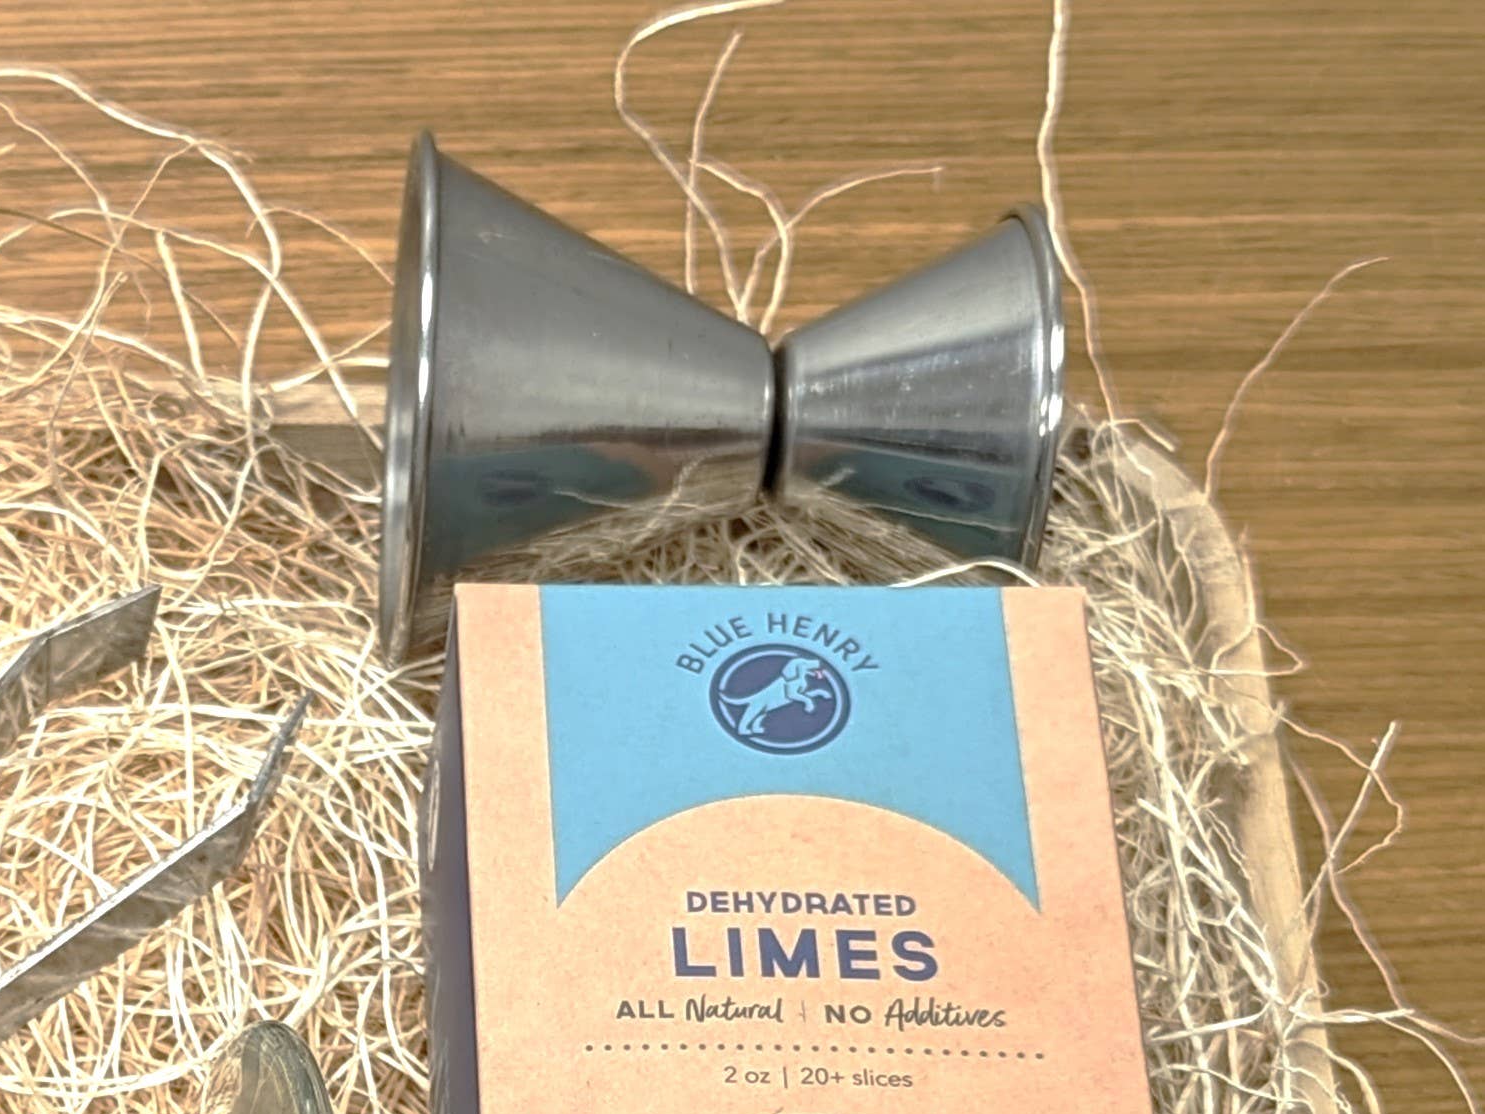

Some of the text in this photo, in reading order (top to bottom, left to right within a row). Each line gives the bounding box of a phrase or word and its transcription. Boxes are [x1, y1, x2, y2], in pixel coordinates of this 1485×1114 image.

[676, 612, 880, 675] BLUE HENRY
[686, 890, 917, 917] DEHYDRATED
[671, 926, 940, 983] LIMES
[616, 995, 1007, 1032] ALL Natural NO Additives
[723, 1066, 914, 1088] 2 oz 20+ slices
